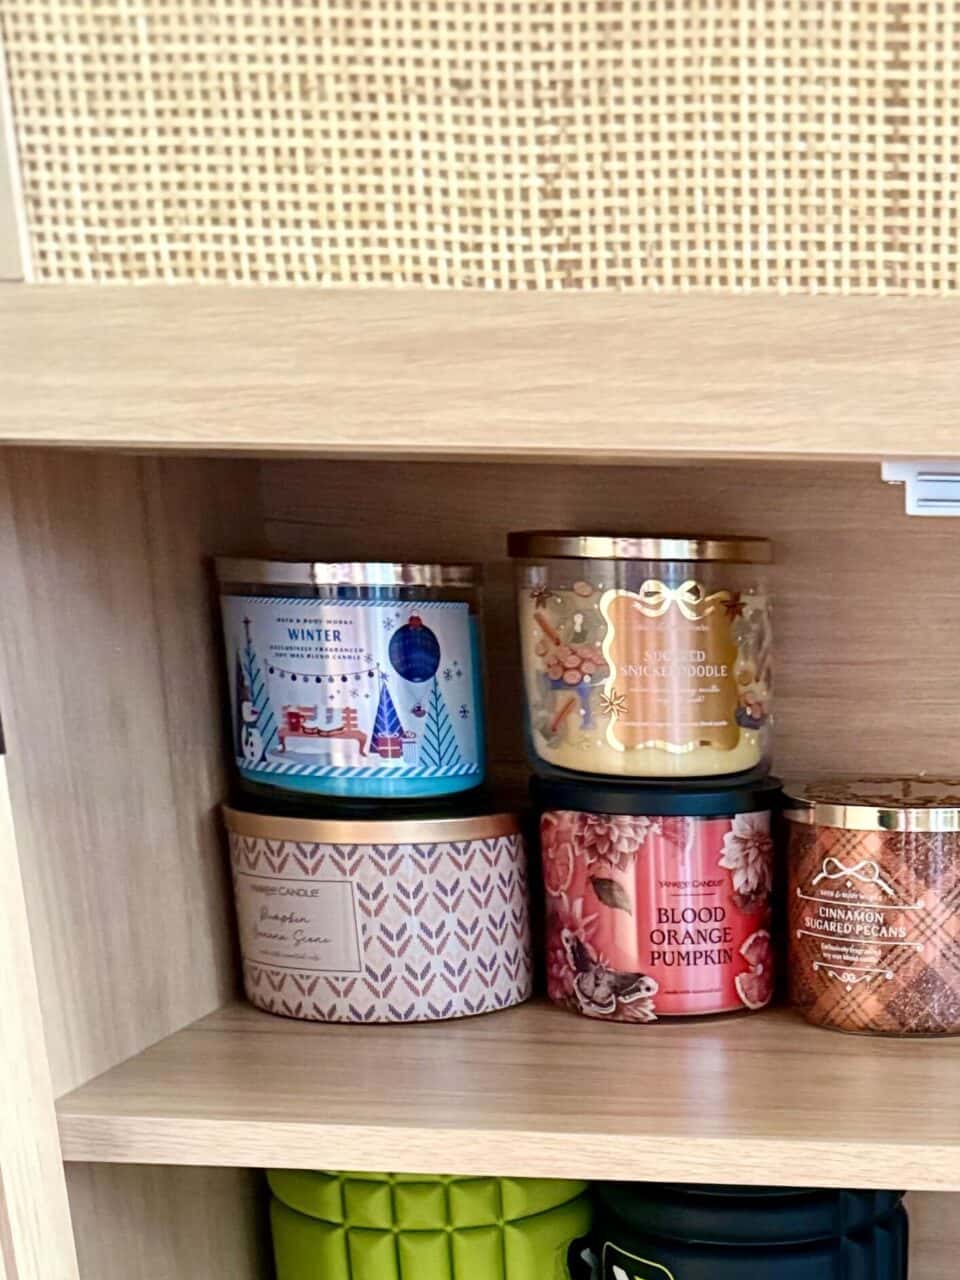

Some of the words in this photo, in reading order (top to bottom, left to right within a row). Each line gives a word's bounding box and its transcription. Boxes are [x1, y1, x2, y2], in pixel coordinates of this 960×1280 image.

[288, 628, 342, 642] WINTER
[644, 650, 706, 662] SUGED
[622, 664, 728, 677] SNICKEOODLE
[657, 906, 726, 924] BLOOD
[819, 906, 884, 924] CINNAMON
[650, 927, 733, 945] ORANGE
[804, 916, 853, 934] SUGARED
[855, 924, 906, 938] PECANS
[650, 948, 734, 967] PUMPKIN
